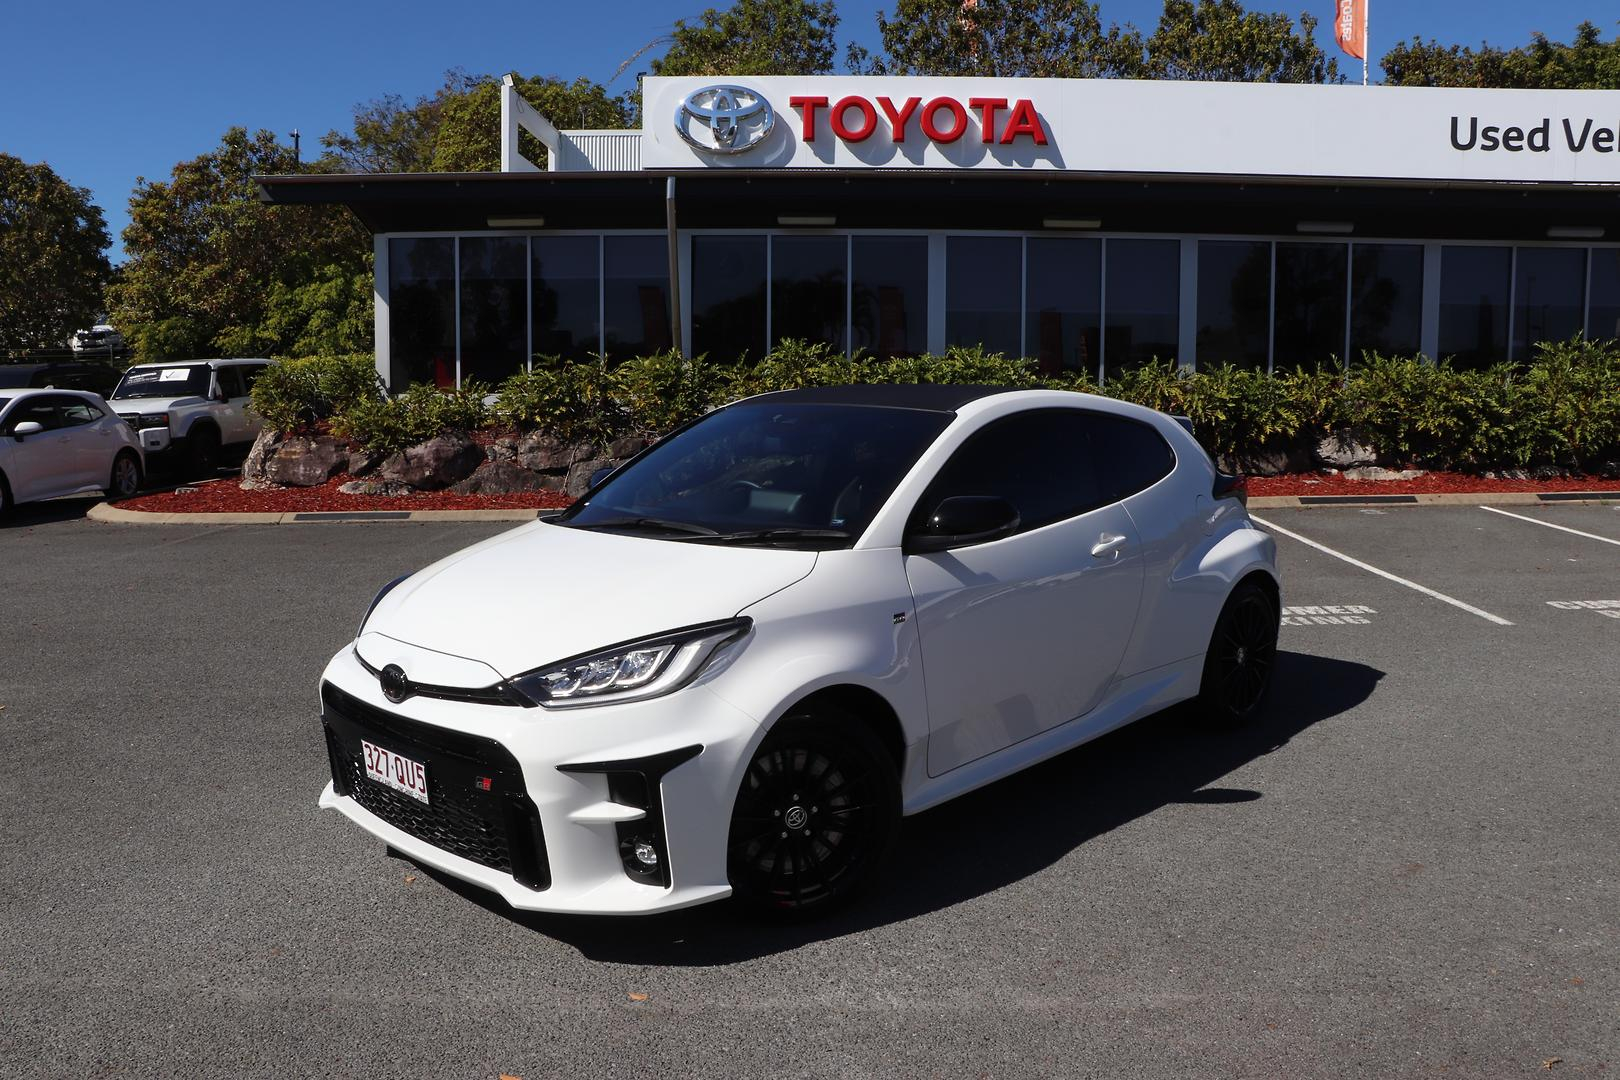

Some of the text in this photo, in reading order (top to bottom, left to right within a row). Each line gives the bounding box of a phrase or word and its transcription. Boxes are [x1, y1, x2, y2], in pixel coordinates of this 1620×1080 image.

[789, 95, 1049, 145] TOYOTA
[1450, 116, 1620, 153] Used Ve
